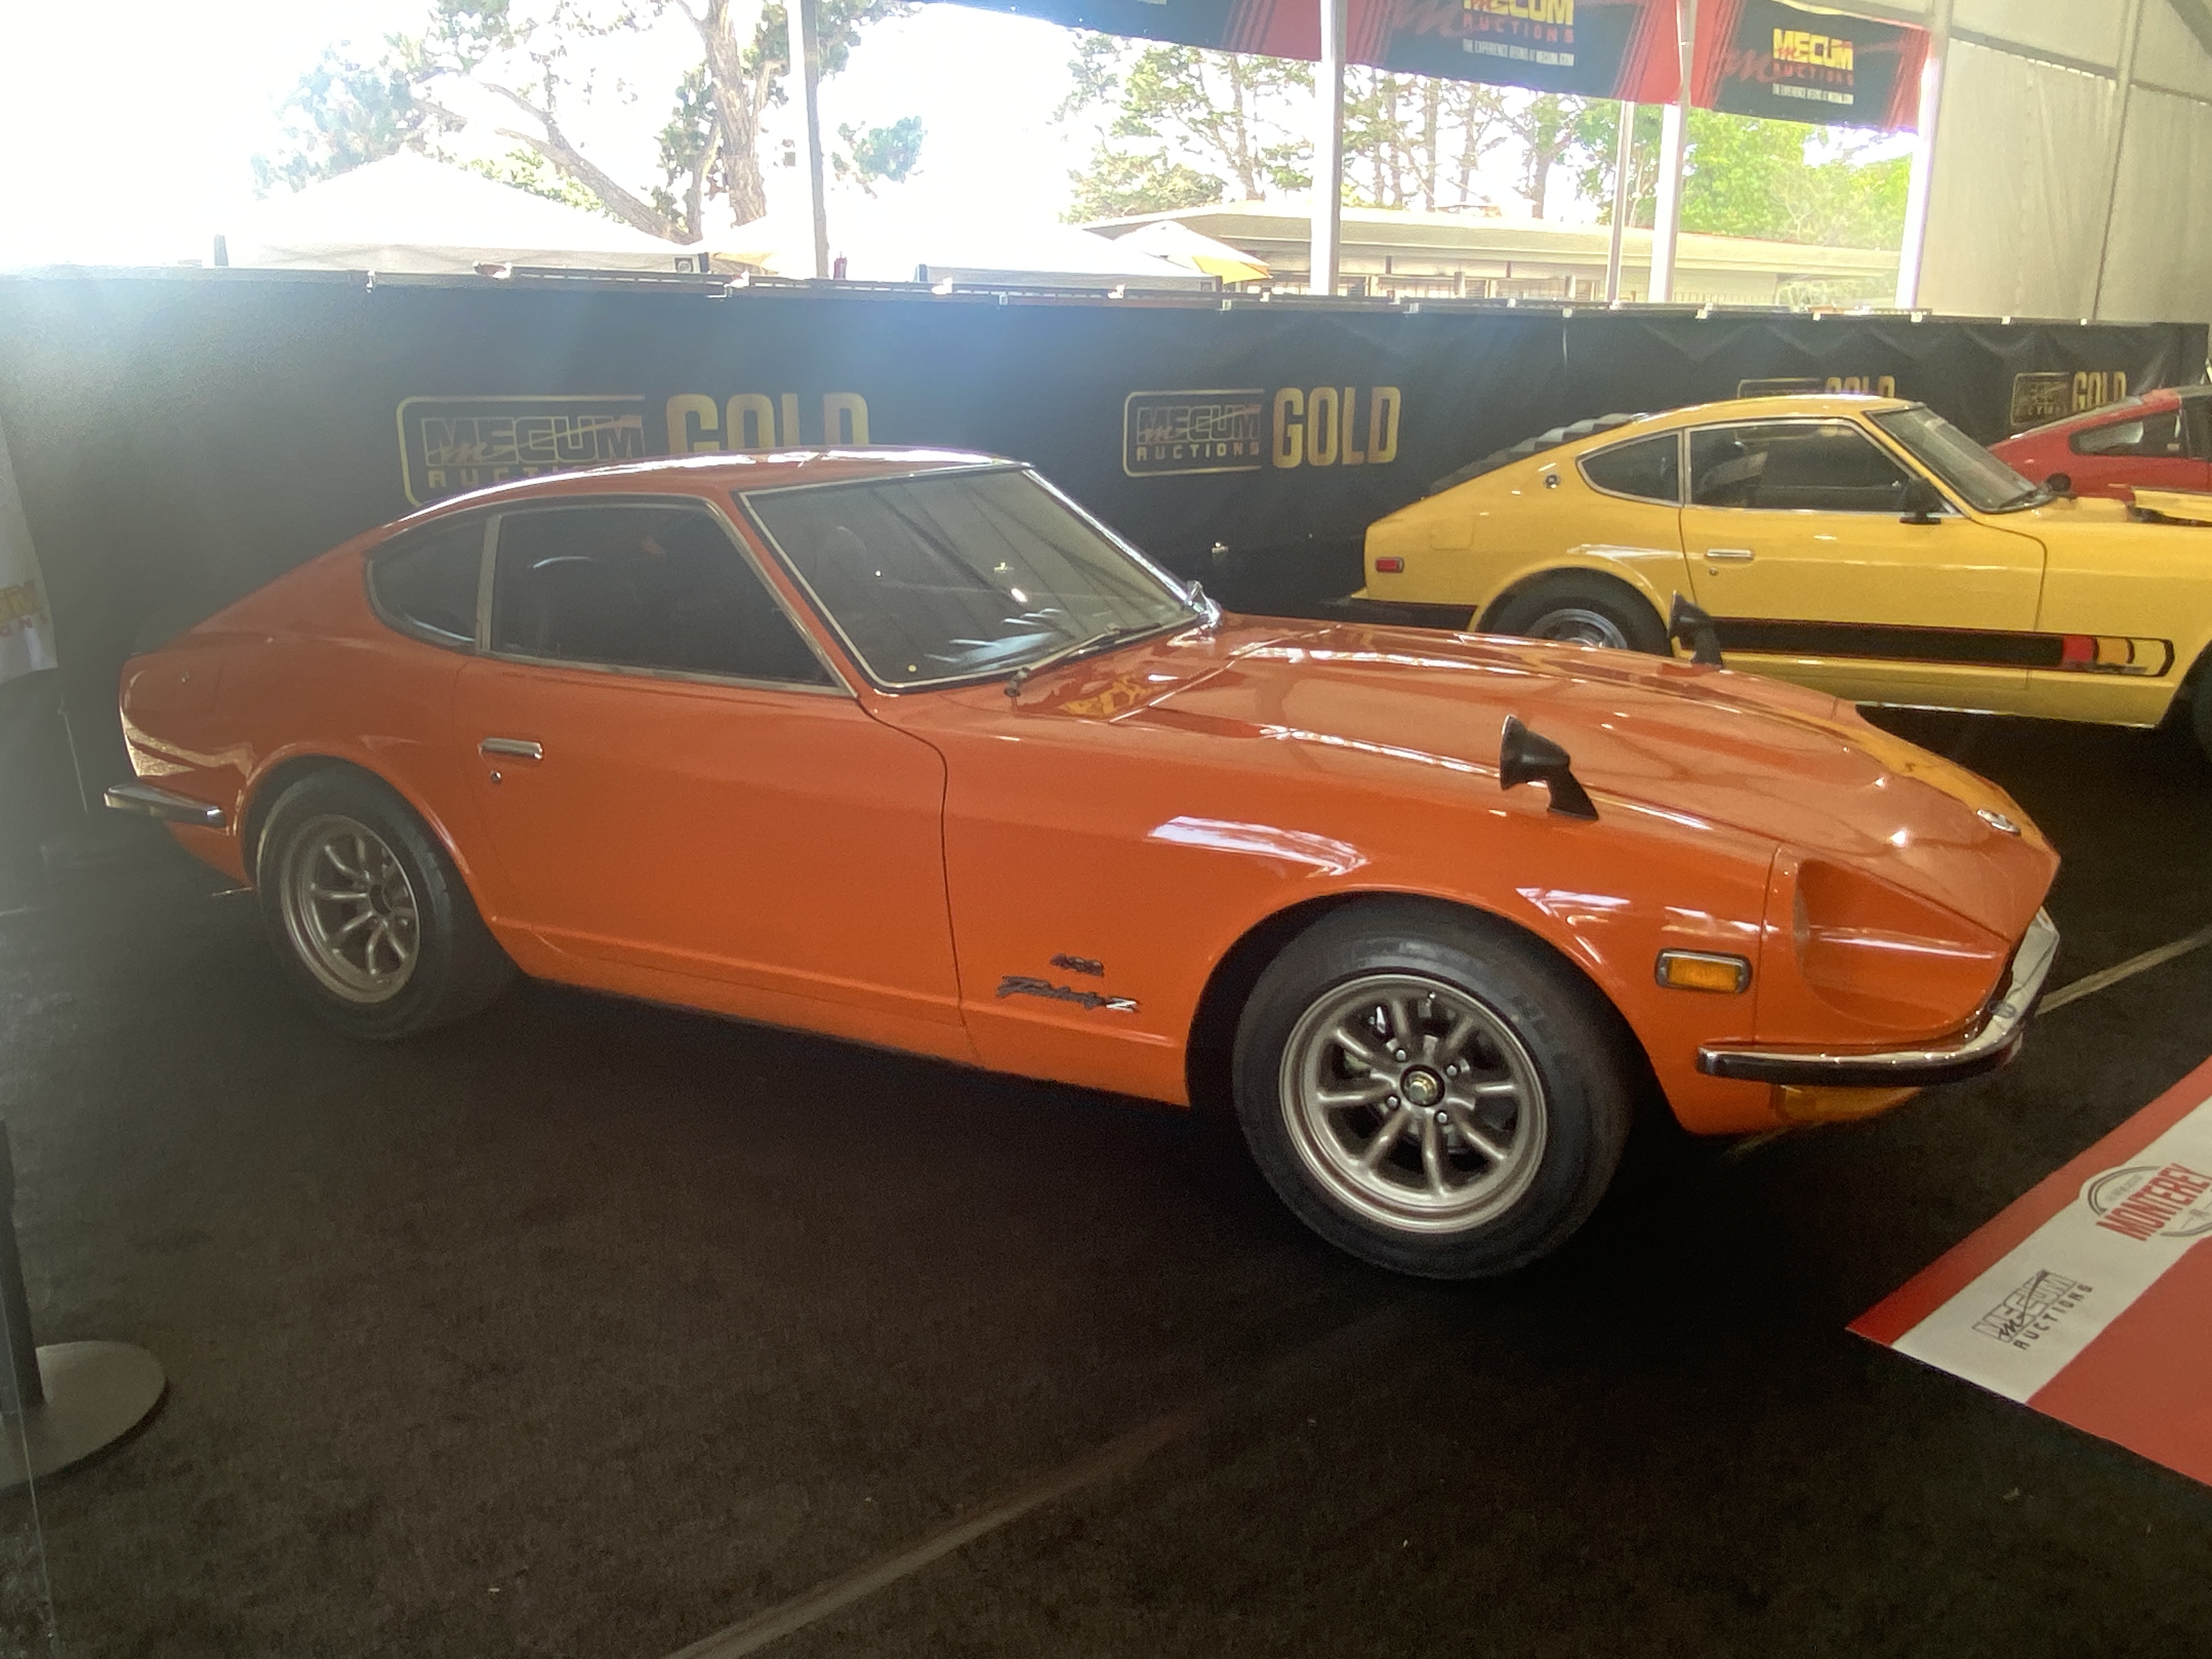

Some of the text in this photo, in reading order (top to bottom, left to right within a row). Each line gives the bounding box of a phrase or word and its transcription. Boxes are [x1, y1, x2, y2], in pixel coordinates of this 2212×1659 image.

[1773, 28, 1853, 71] MECUM
[421, 415, 646, 466] MECUM
[1136, 441, 1260, 461] AUCTIONS
[1137, 386, 1401, 469] MECUM GOLD
[2095, 1162, 2212, 1242] MONTEREY
[1972, 1269, 2078, 1344] MECUM
[2012, 1283, 2094, 1351] AUCTIONS
